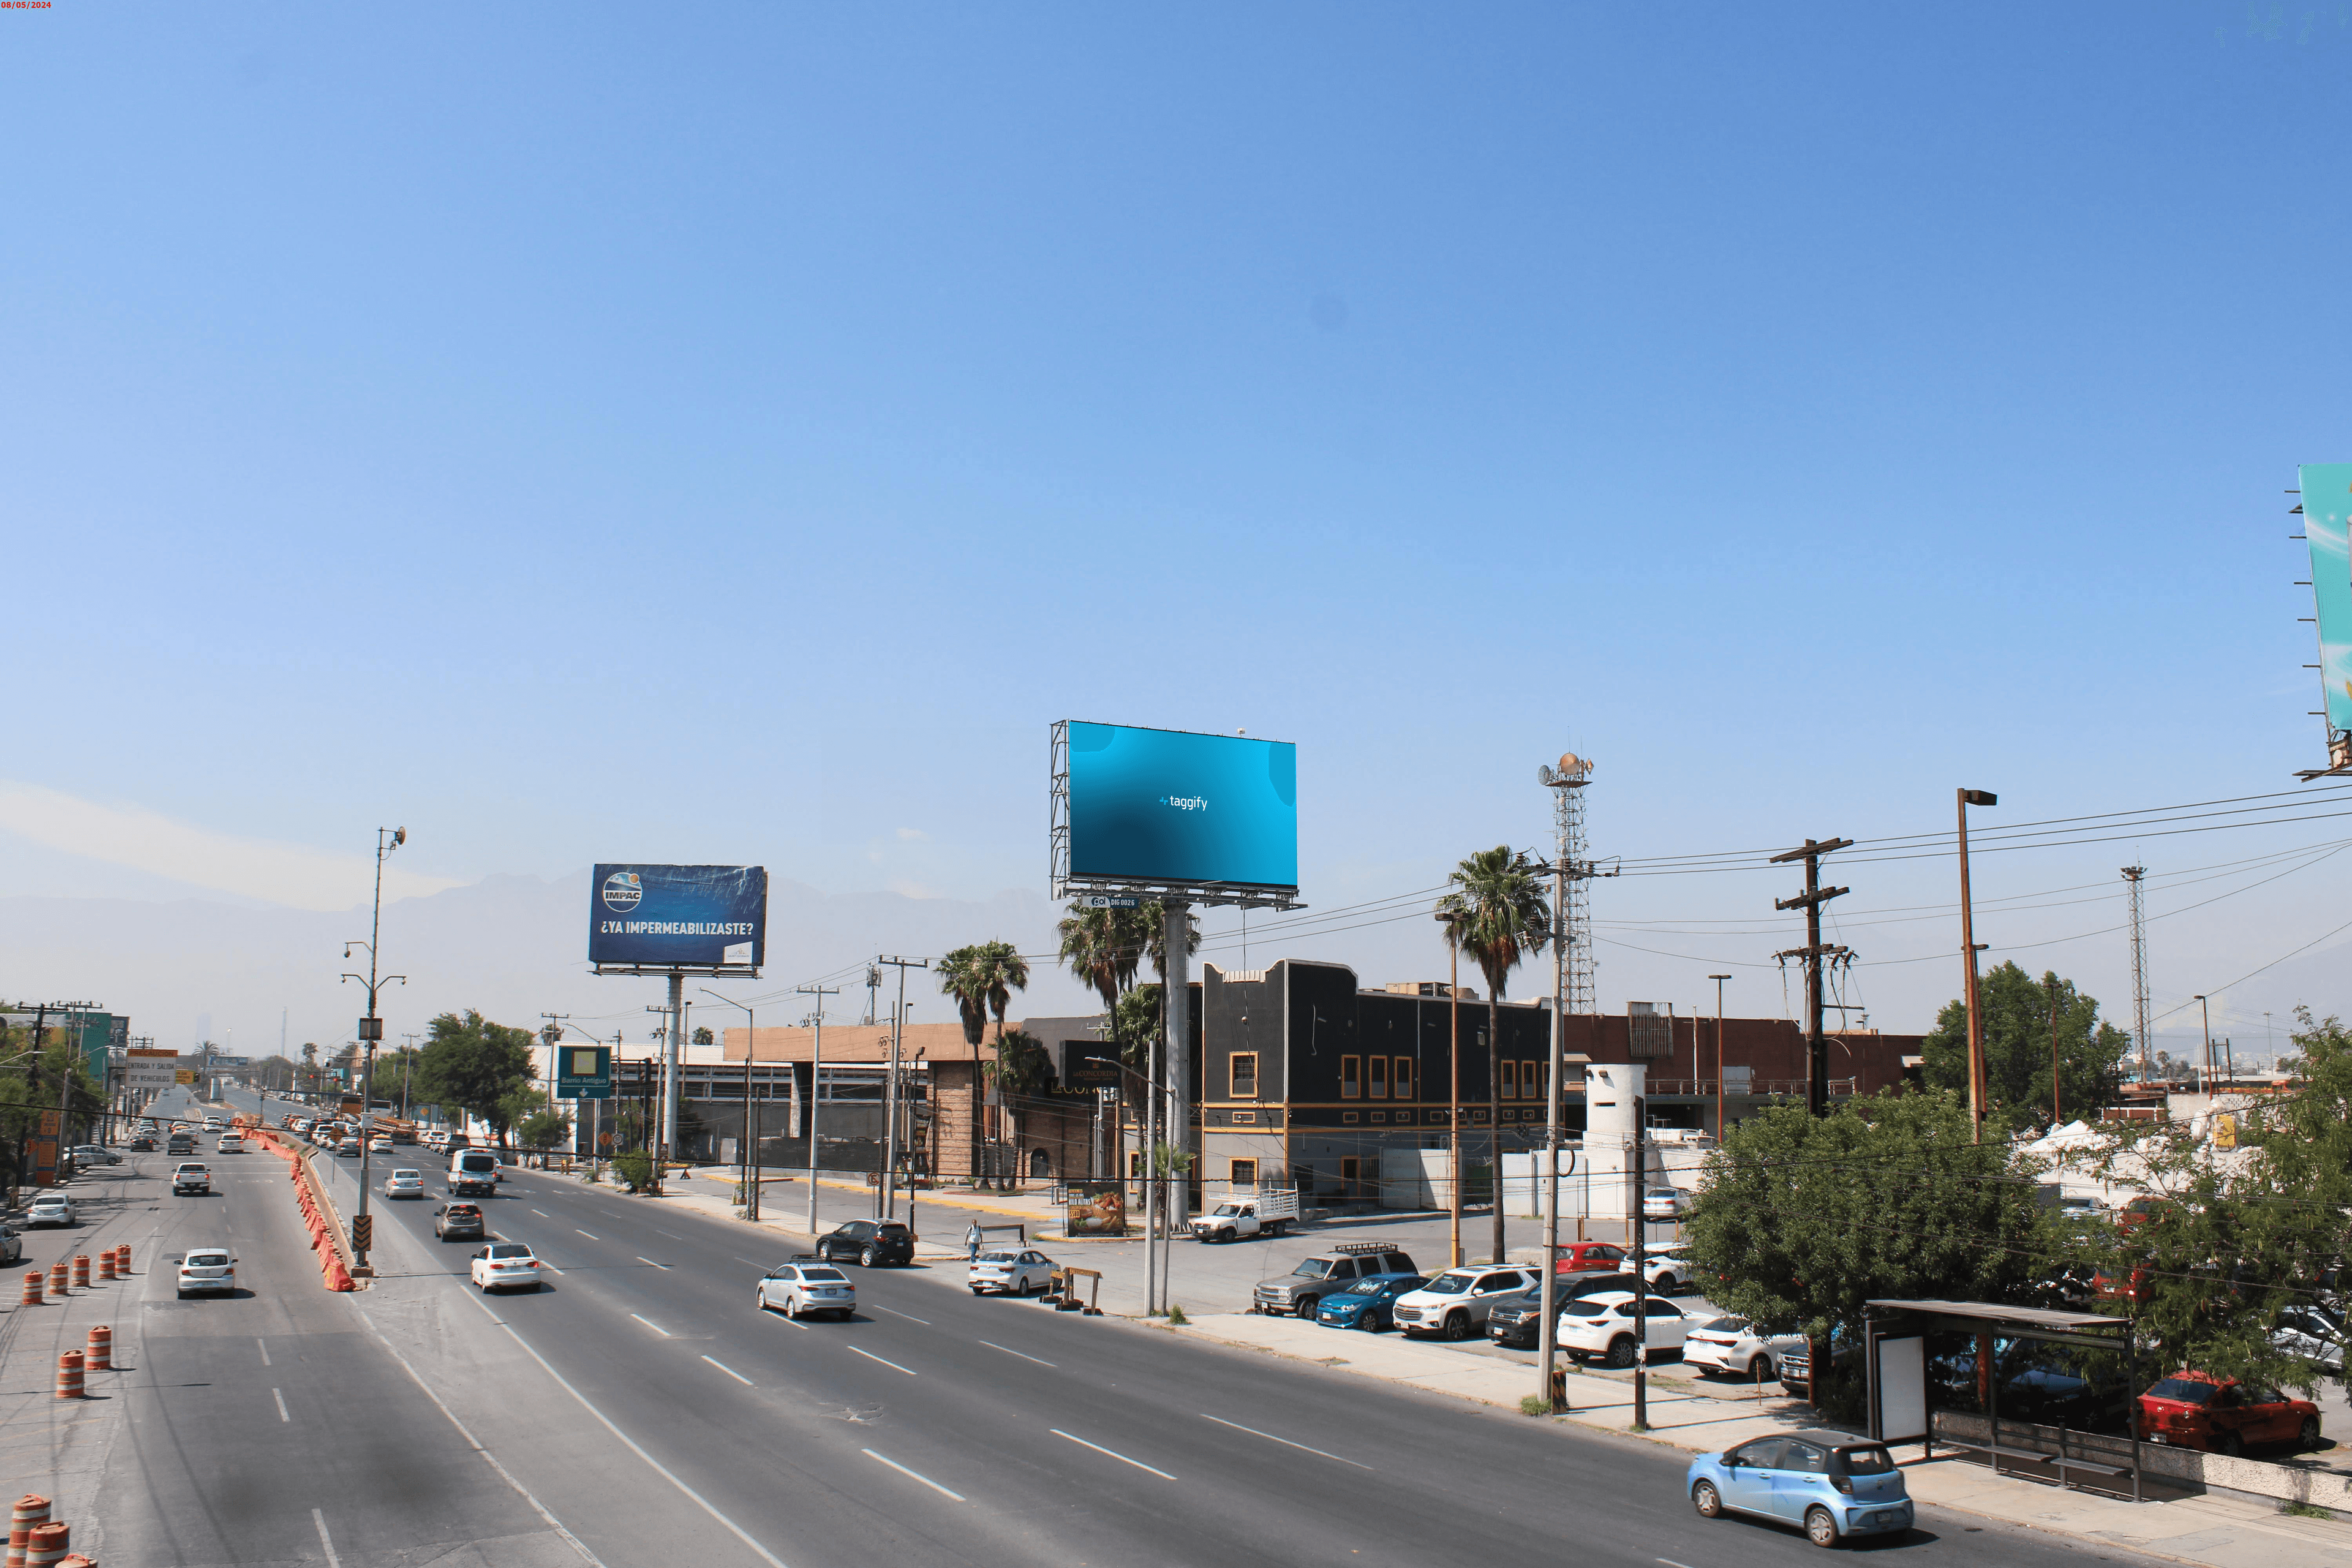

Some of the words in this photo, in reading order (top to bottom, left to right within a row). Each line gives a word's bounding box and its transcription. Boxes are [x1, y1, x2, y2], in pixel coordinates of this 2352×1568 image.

[1170, 796, 1207, 812] taggify
[600, 921, 624, 933] ¿YA
[625, 921, 754, 935] IMPERMEABILIZASTE?
